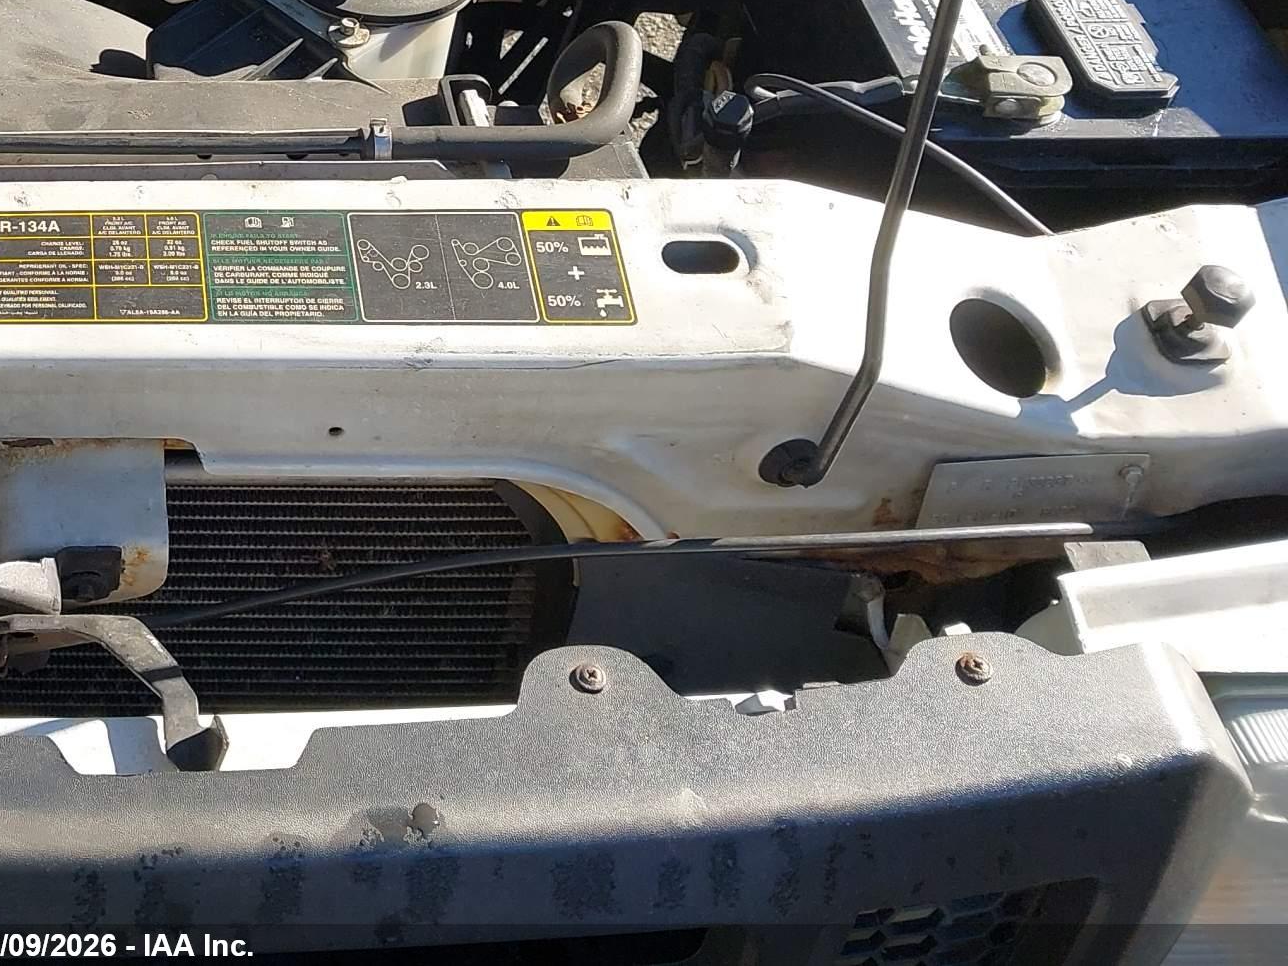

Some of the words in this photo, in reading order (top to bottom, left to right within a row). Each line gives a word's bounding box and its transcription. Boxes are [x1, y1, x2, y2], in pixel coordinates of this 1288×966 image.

[1073, 35, 1108, 72] DANGER
[0, 220, 60, 232] R-134A
[536, 242, 569, 253] 50%
[547, 296, 581, 307] 50%
